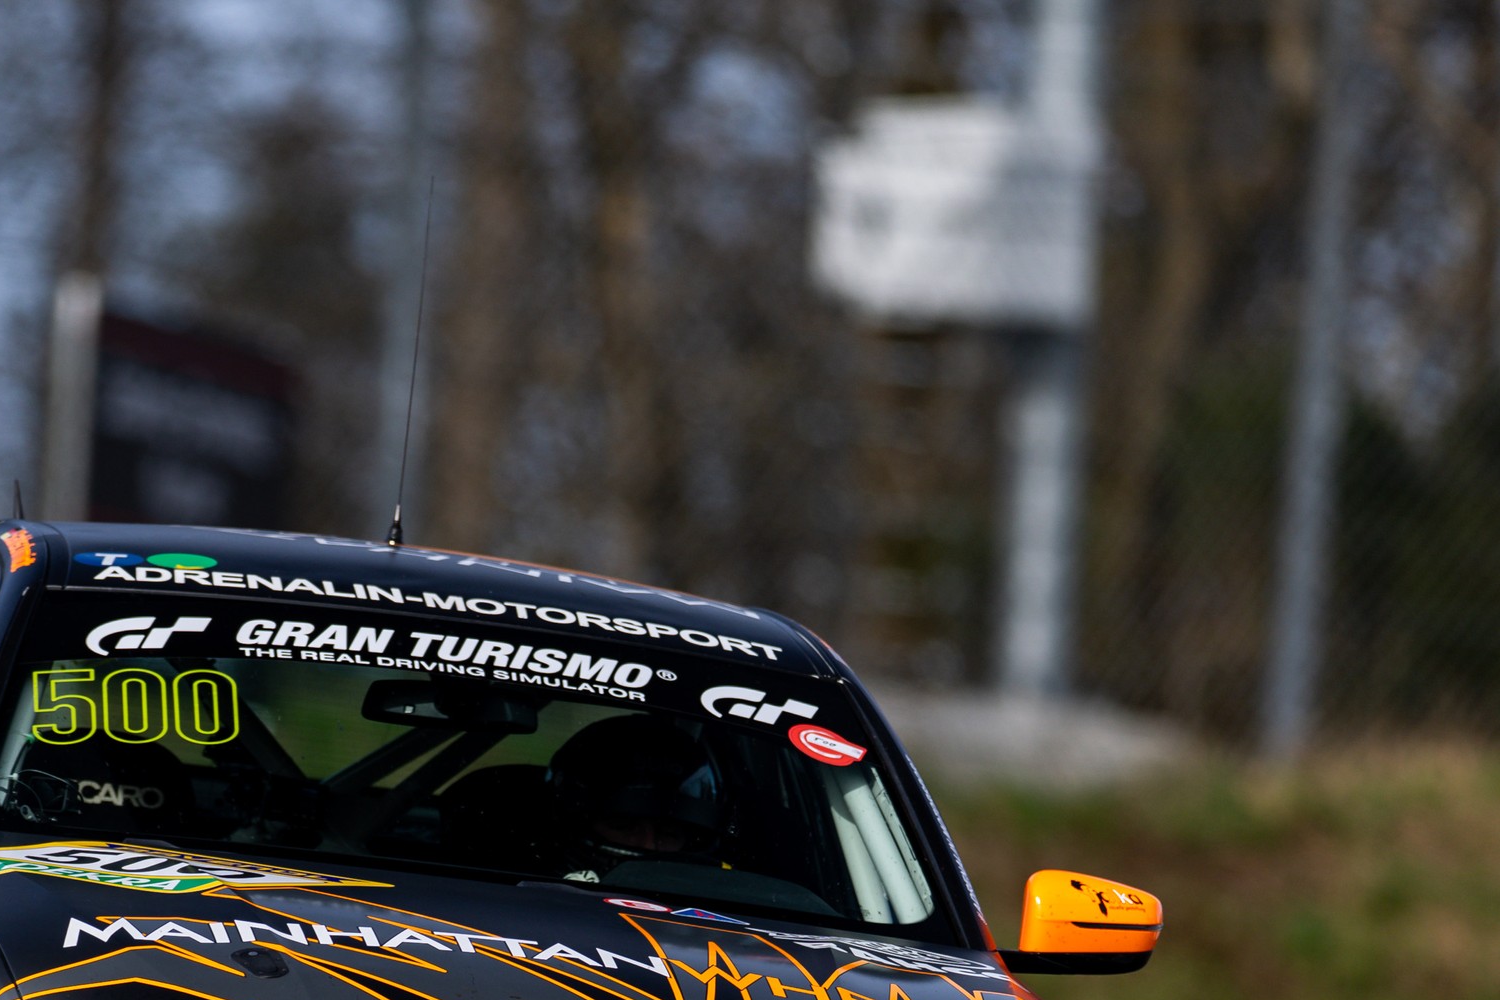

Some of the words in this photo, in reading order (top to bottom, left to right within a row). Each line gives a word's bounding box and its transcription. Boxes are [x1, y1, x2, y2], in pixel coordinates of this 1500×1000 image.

[93, 565, 783, 661] ADRENALIN-MOTORSPORT
[235, 618, 395, 656] GRAN
[238, 646, 293, 660] THE
[300, 650, 371, 666] REAL
[376, 656, 486, 679] DRIVING
[492, 669, 647, 703] SIMULATOR
[31, 667, 240, 746] 500
[72, 779, 166, 810] CARO
[0, 860, 184, 891] DEKRA
[62, 917, 673, 979] MAINHATTAN
